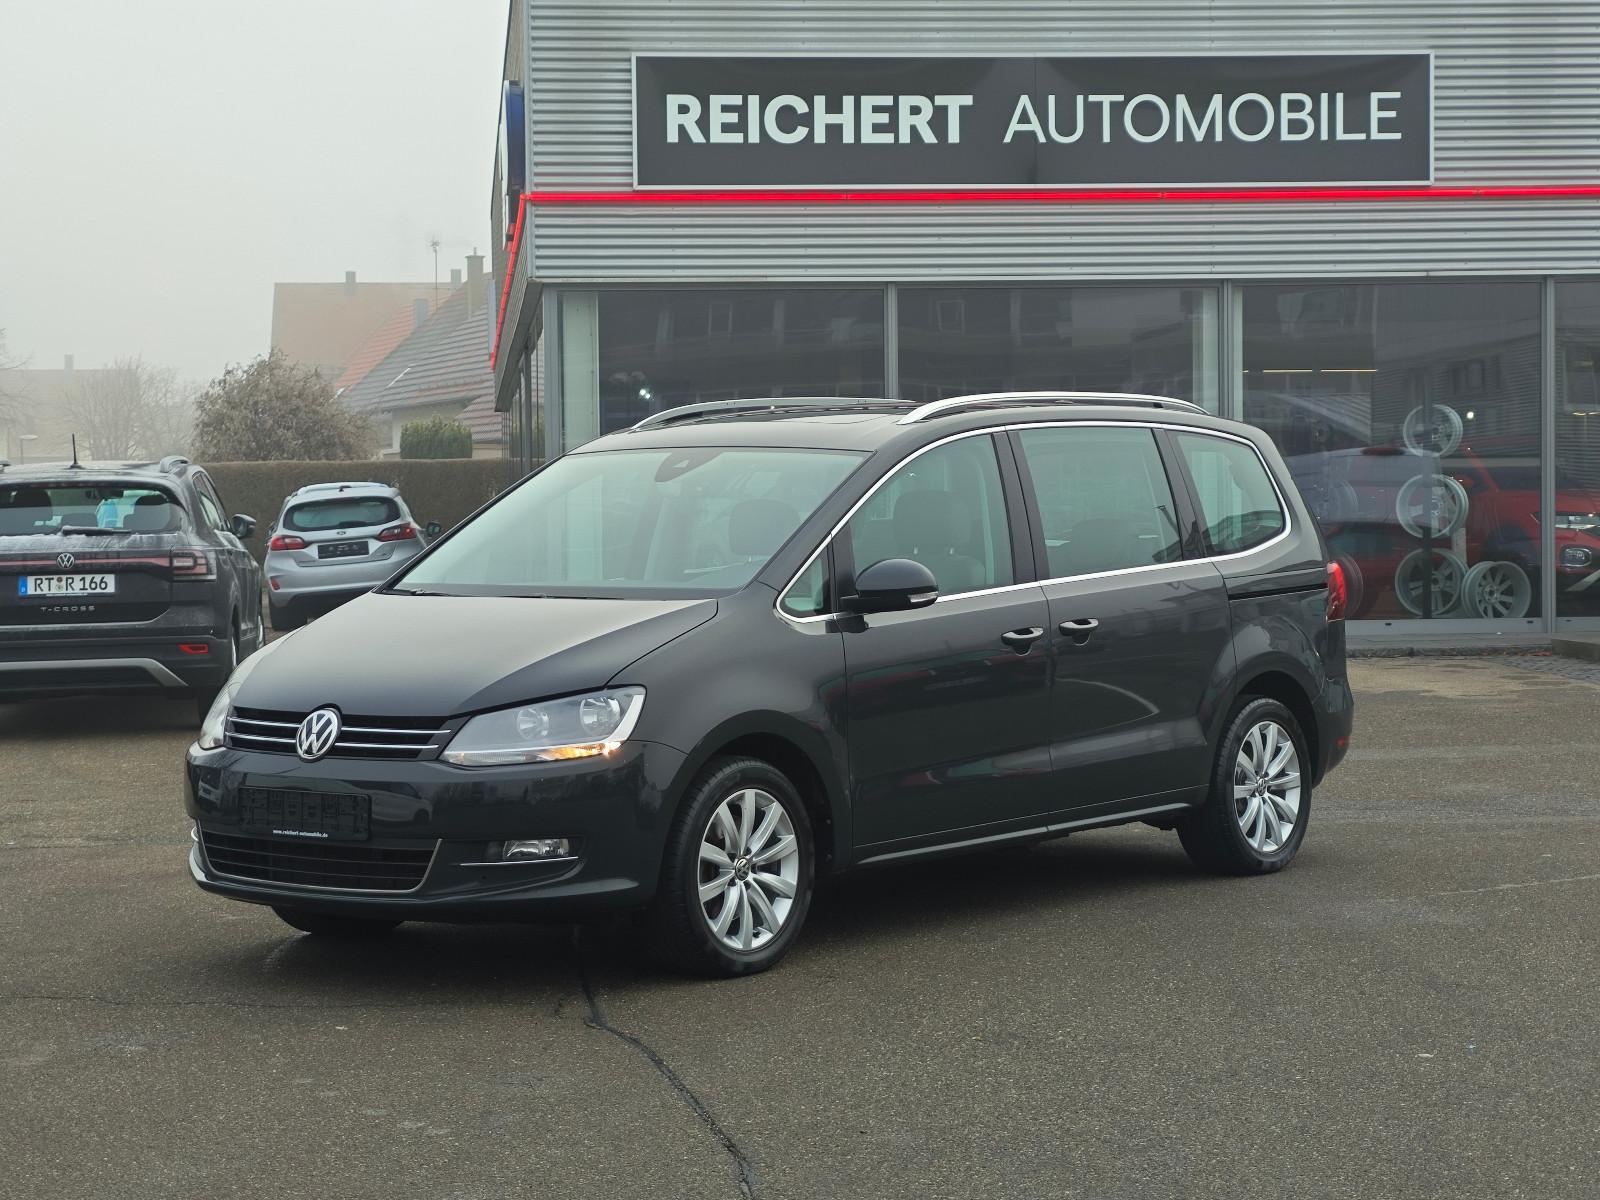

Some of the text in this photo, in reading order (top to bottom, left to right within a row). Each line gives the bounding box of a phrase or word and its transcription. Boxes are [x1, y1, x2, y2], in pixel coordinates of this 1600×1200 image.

[667, 92, 1402, 144] REICHERT AUTOMOBILE
[34, 576, 108, 592] RT R 166
[297, 709, 338, 759] VW
